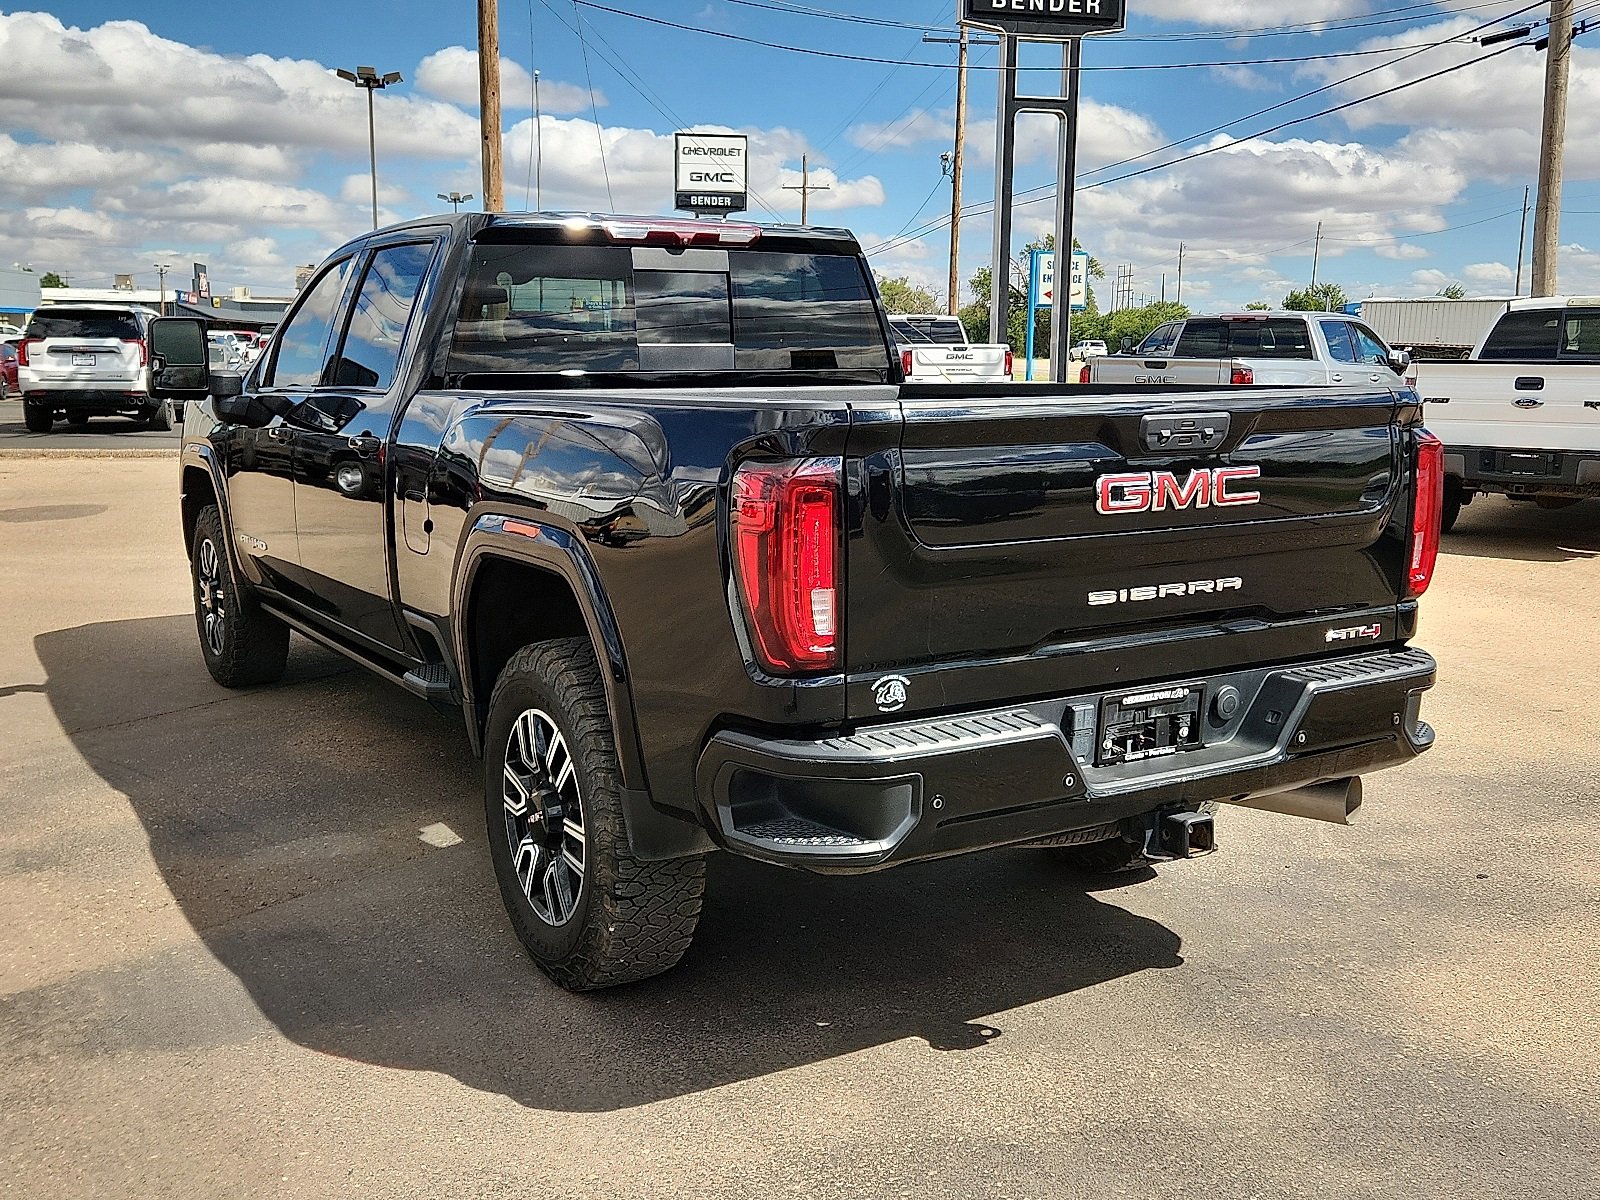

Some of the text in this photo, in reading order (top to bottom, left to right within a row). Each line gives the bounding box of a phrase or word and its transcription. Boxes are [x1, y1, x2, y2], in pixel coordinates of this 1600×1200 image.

[682, 146, 742, 157] CHEVROLET
[689, 172, 735, 183] GMC
[690, 196, 731, 206] BENDER
[1134, 374, 1178, 384] GMC
[1096, 465, 1261, 515] GMC
[1087, 576, 1243, 606] SIERRA
